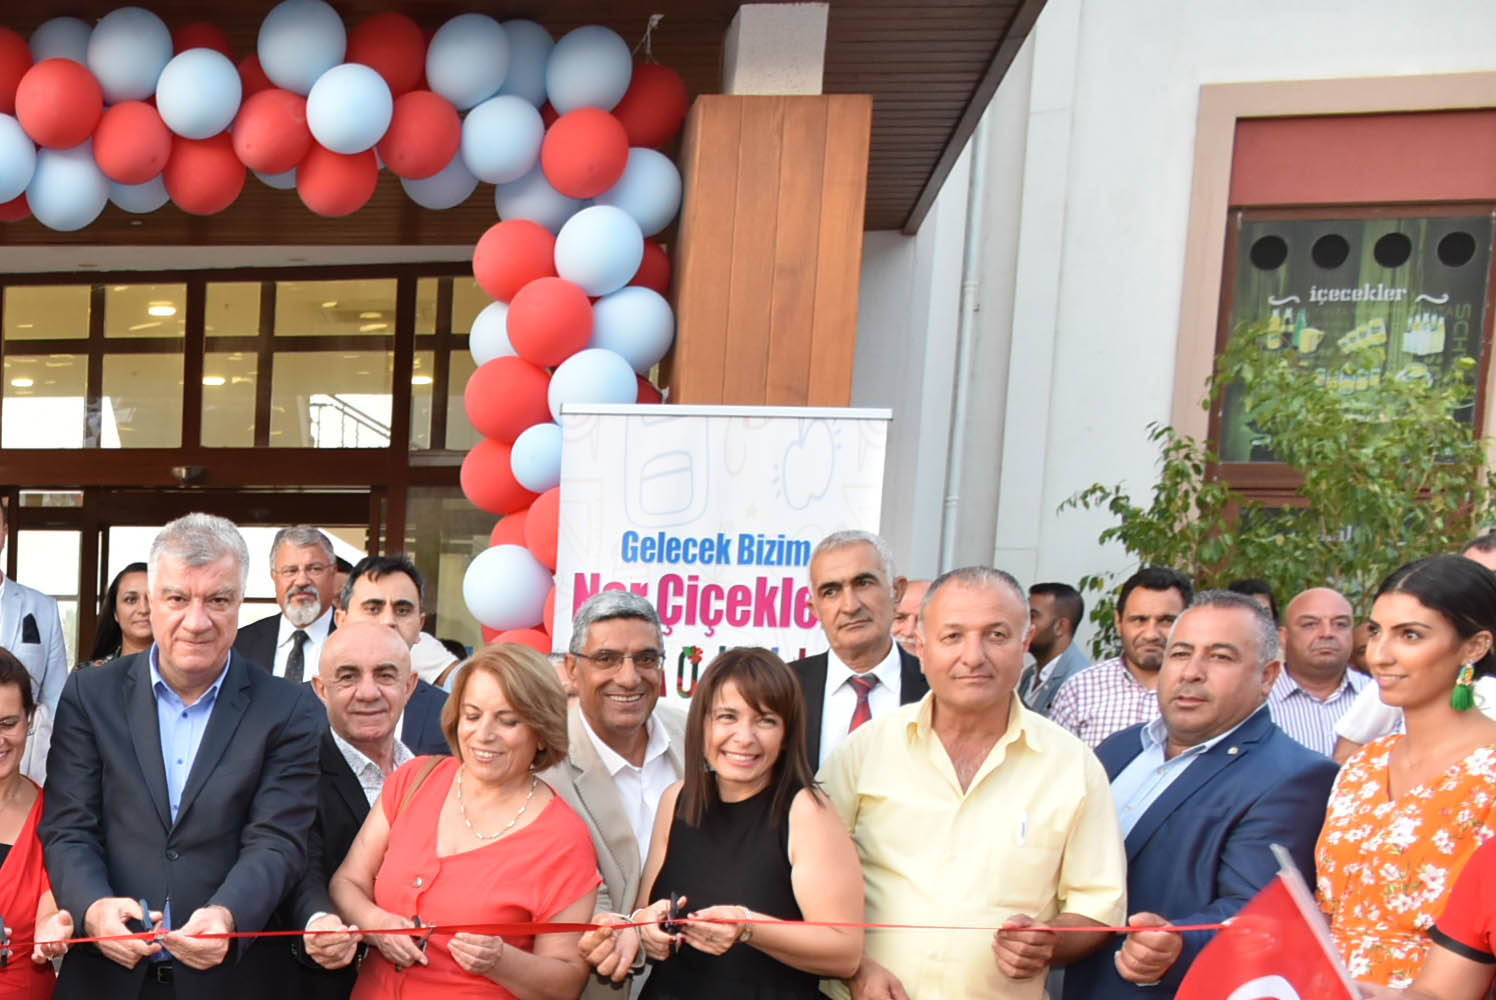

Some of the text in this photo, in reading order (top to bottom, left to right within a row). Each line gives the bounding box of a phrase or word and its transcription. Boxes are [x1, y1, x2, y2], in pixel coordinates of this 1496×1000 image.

[1309, 283, 1408, 306] içecekler
[621, 530, 812, 567] Gelecek Bizim
[656, 573, 821, 637] Çiçekle
